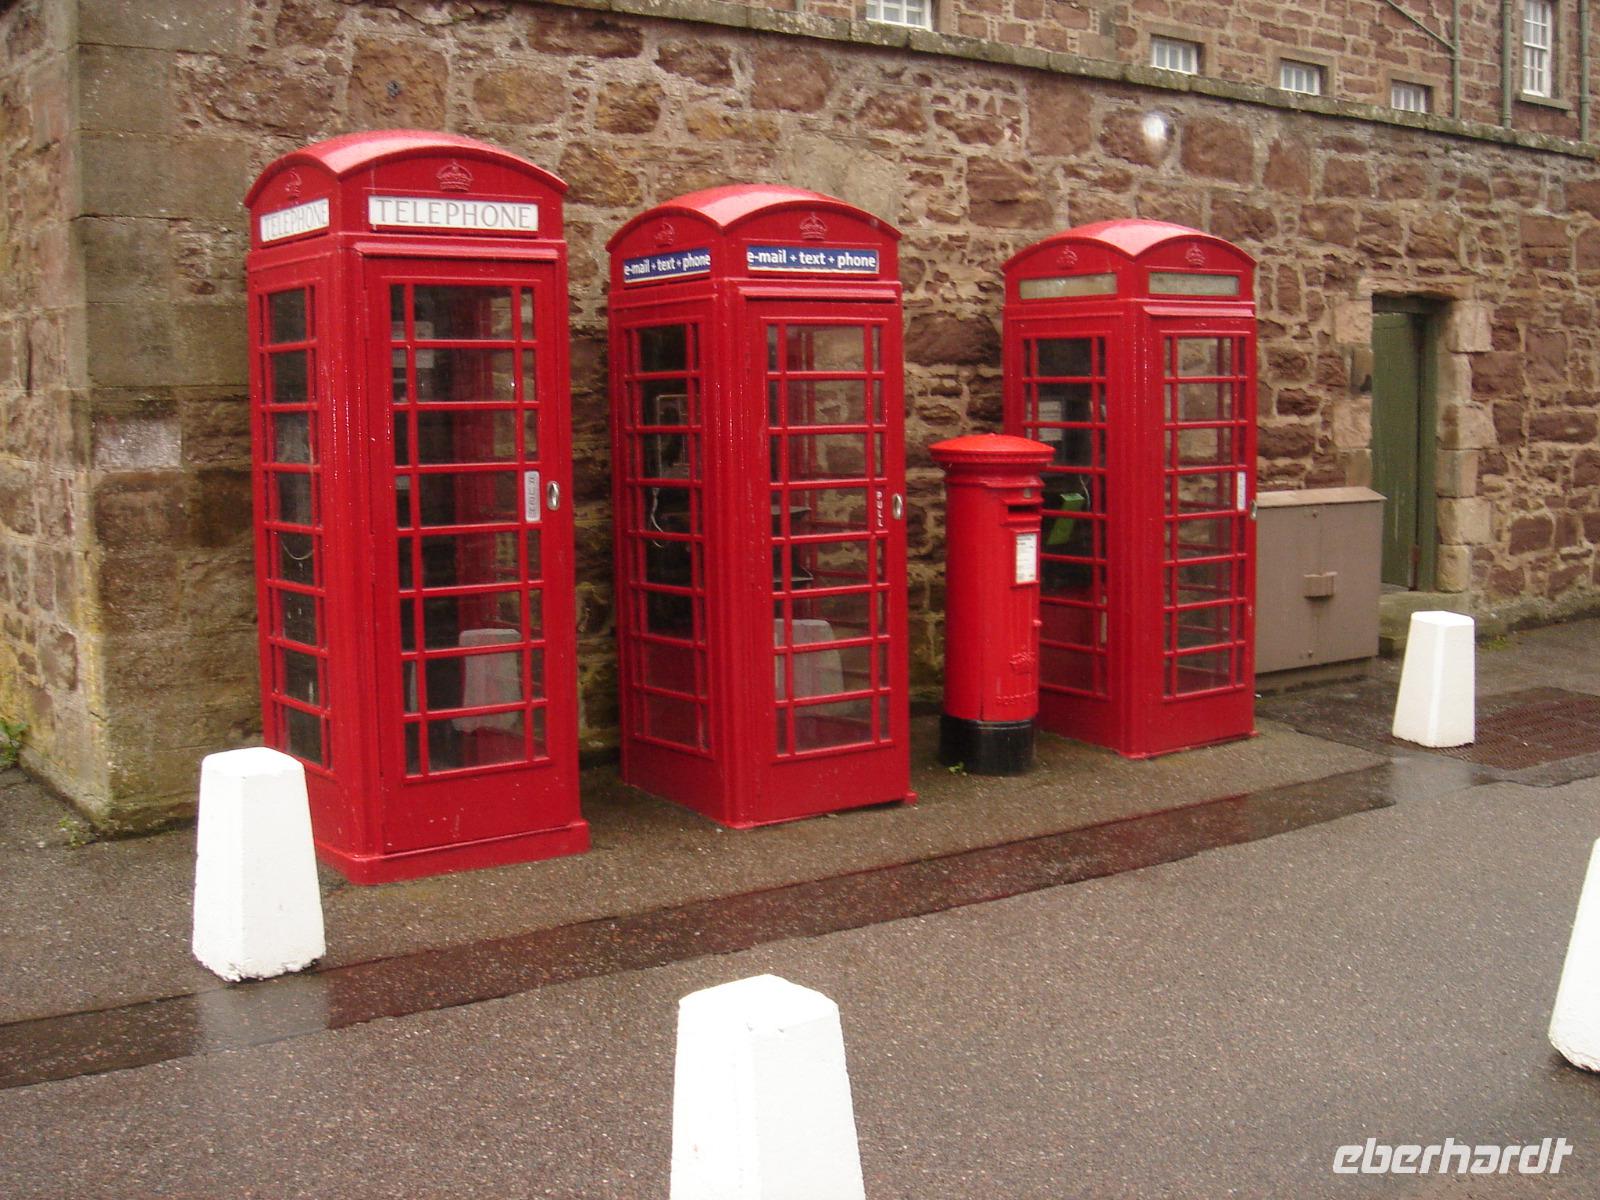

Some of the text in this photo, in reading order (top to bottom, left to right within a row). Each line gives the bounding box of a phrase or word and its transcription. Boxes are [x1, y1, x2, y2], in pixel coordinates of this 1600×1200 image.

[264, 201, 328, 239] TELEPHONE
[375, 199, 531, 229] TELEPHONE
[624, 259, 650, 275] e-mail
[656, 257, 675, 271] text
[682, 252, 711, 271] phone
[747, 249, 786, 263] e-mail
[799, 251, 826, 265] text
[837, 252, 876, 268] phone
